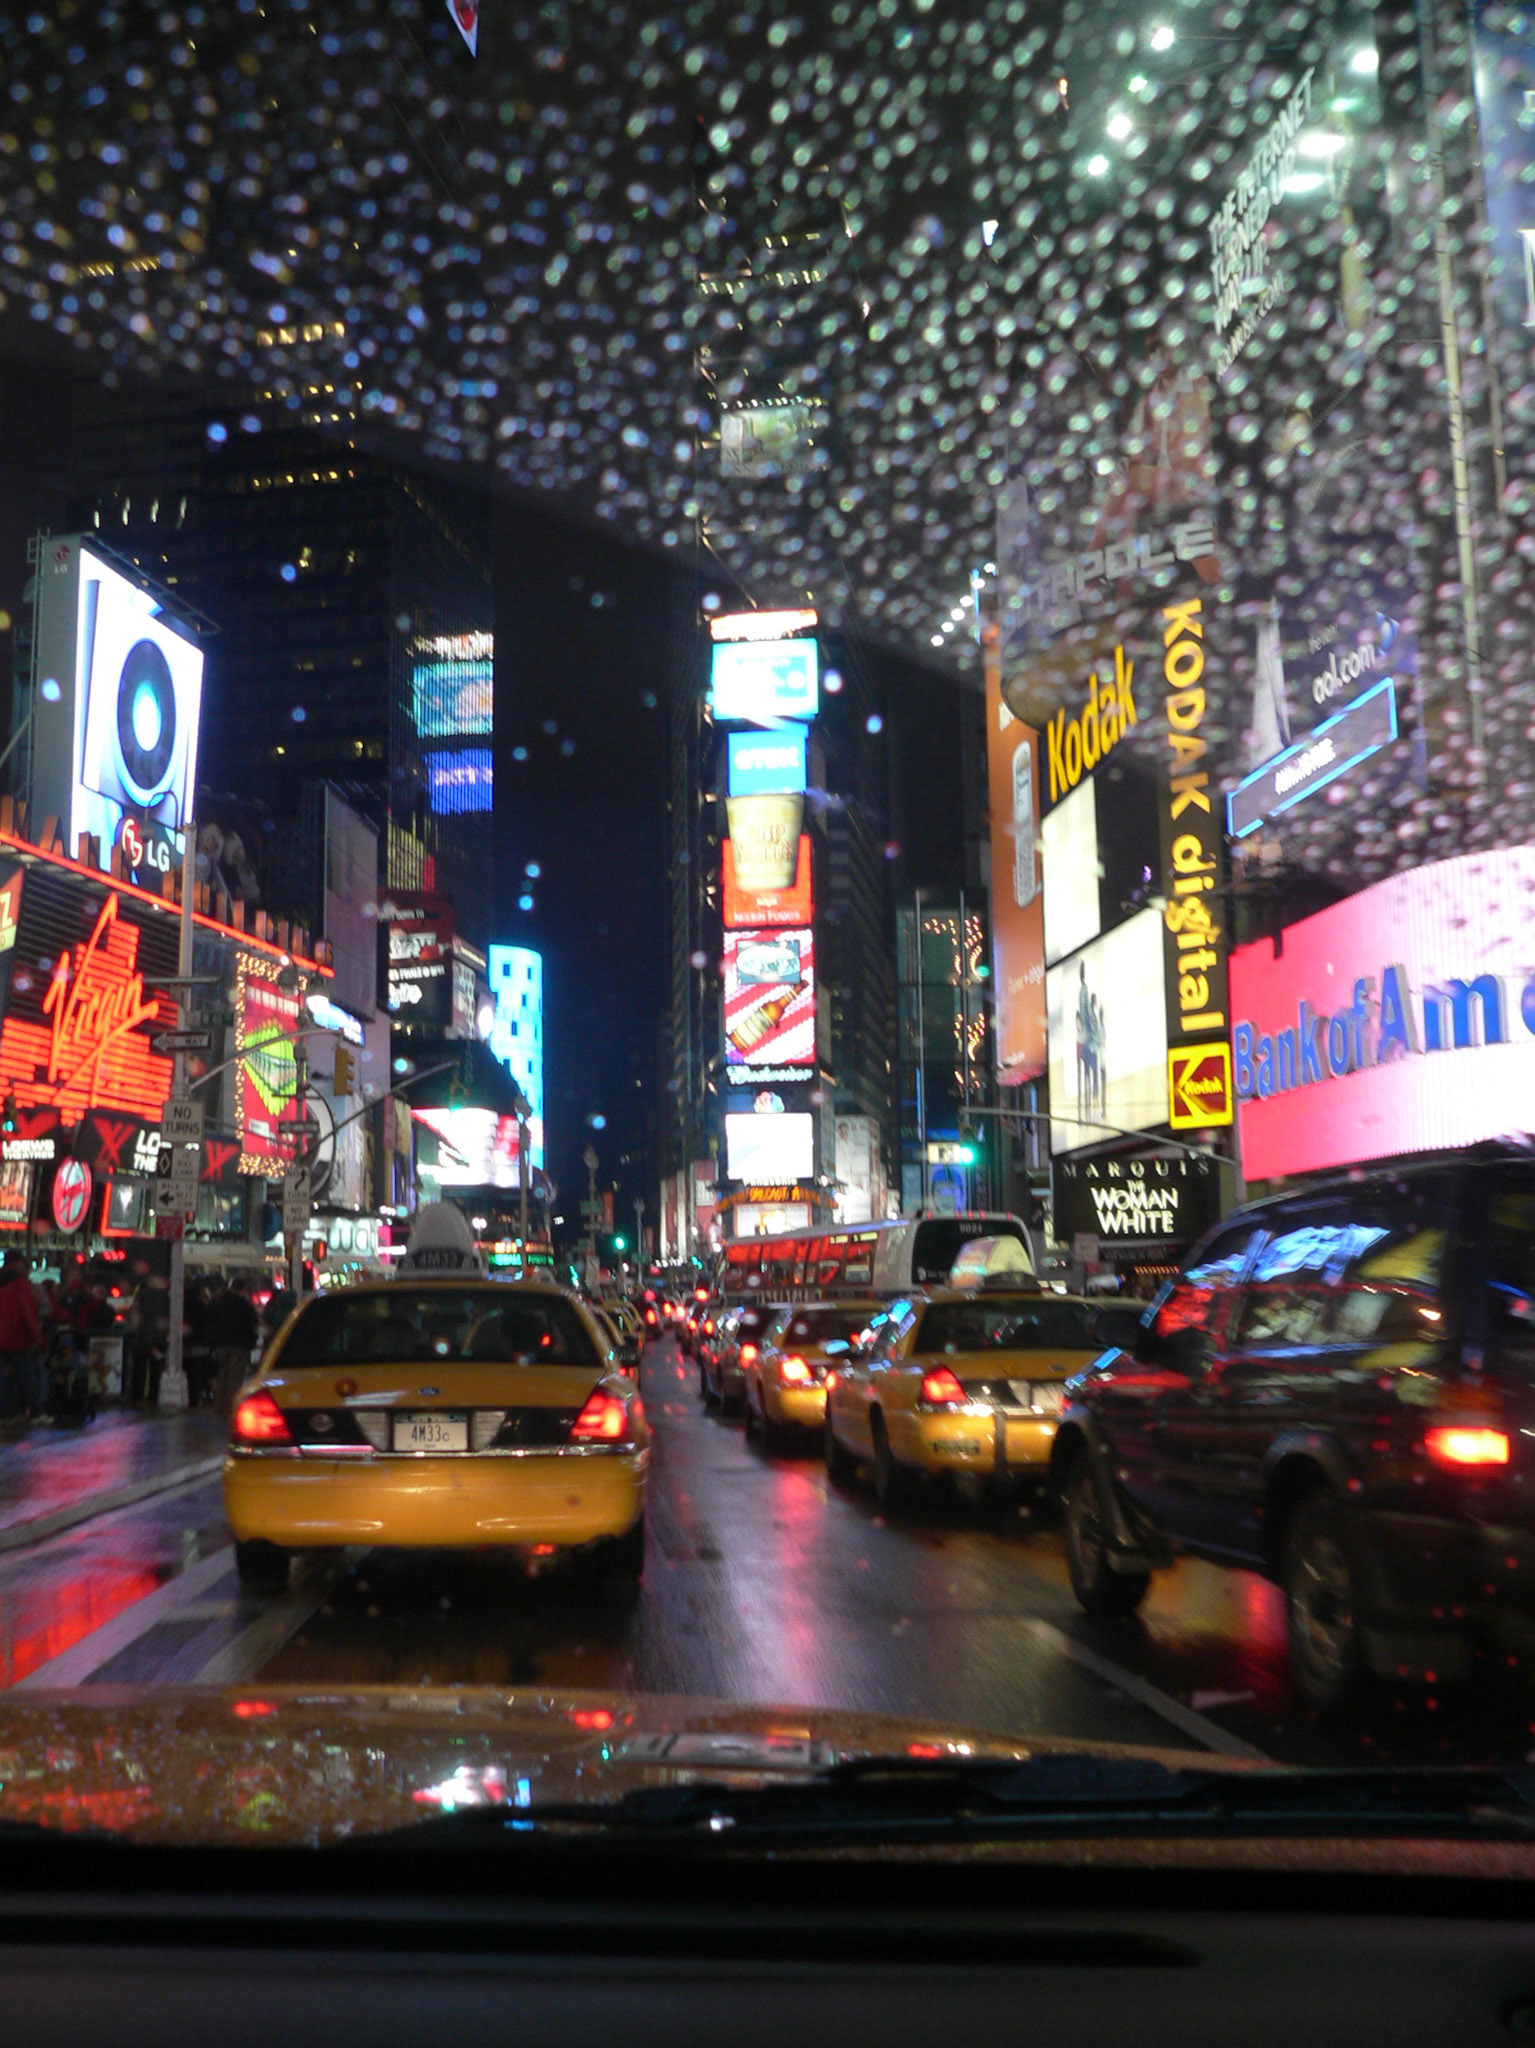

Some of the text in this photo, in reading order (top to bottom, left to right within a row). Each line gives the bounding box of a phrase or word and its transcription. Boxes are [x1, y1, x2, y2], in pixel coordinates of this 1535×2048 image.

[1313, 643, 1376, 704] aol.com
[1047, 644, 1138, 804] Kodak
[1162, 599, 1225, 1031] KODAK digital
[147, 839, 171, 873] LG
[43, 891, 159, 1109] Virgin
[1233, 998, 1328, 1100] Bank
[1327, 976, 1382, 1078] of
[1184, 1075, 1224, 1096] Kodak
[174, 1106, 192, 1121] NO
[165, 1121, 200, 1136] TURNS
[1064, 1159, 1209, 1179] MARQUIS
[1090, 1187, 1179, 1210] WOMAN
[1096, 1209, 1175, 1234] WHITE
